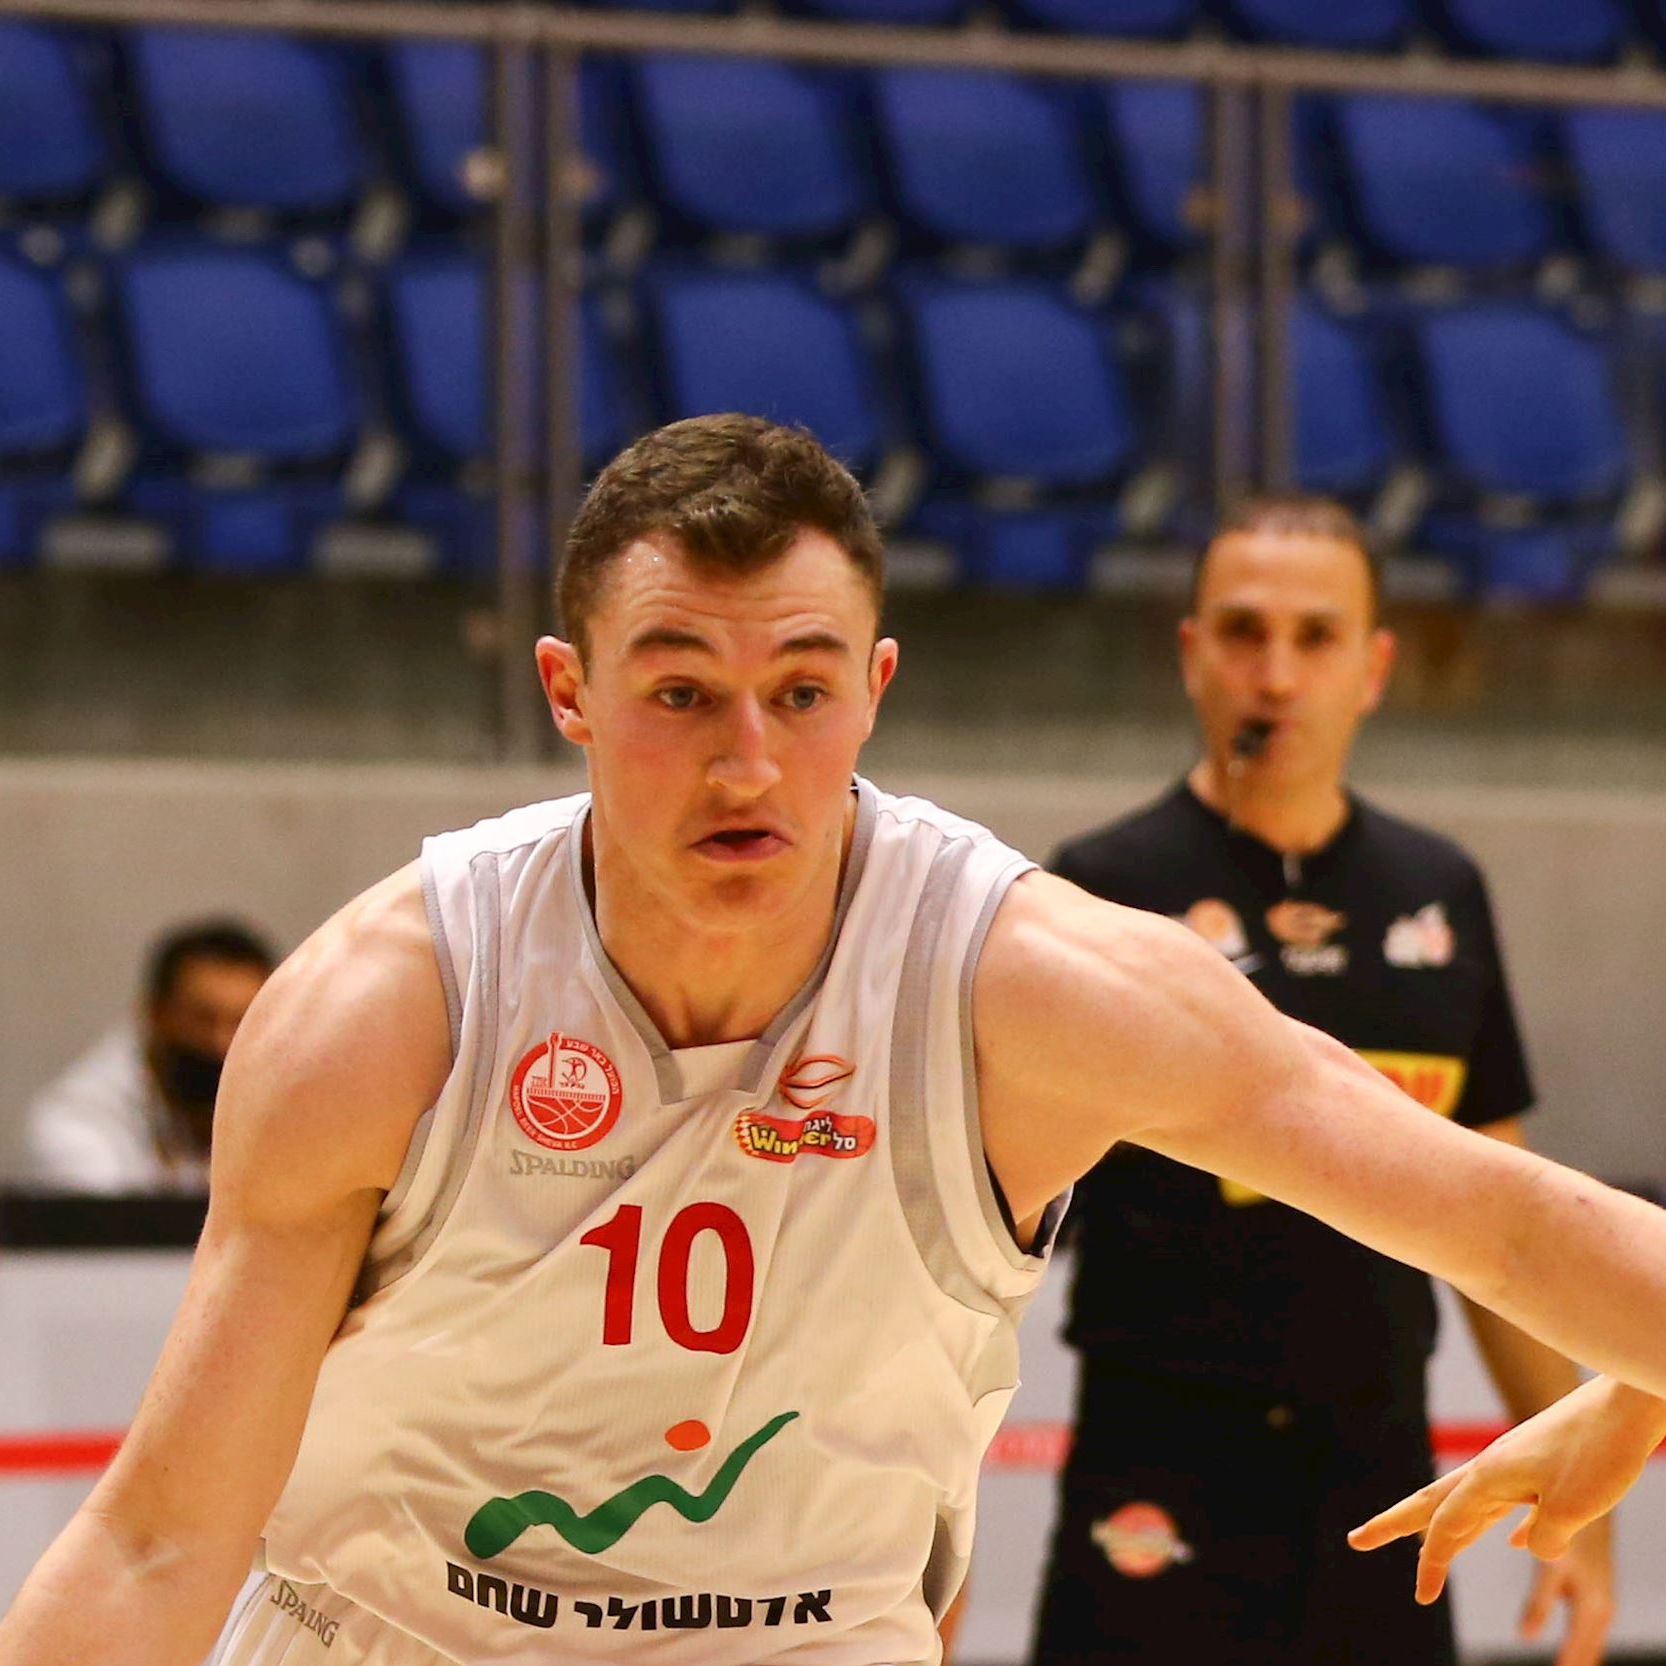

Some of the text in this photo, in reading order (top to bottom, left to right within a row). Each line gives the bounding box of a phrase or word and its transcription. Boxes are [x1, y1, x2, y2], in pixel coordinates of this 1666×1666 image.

[750, 1124, 832, 1155] Winer
[833, 1132, 857, 1150] סל
[510, 1149, 633, 1181] SPALDING
[579, 1201, 755, 1355] 10
[446, 1560, 833, 1631] אלטשולר שחם
